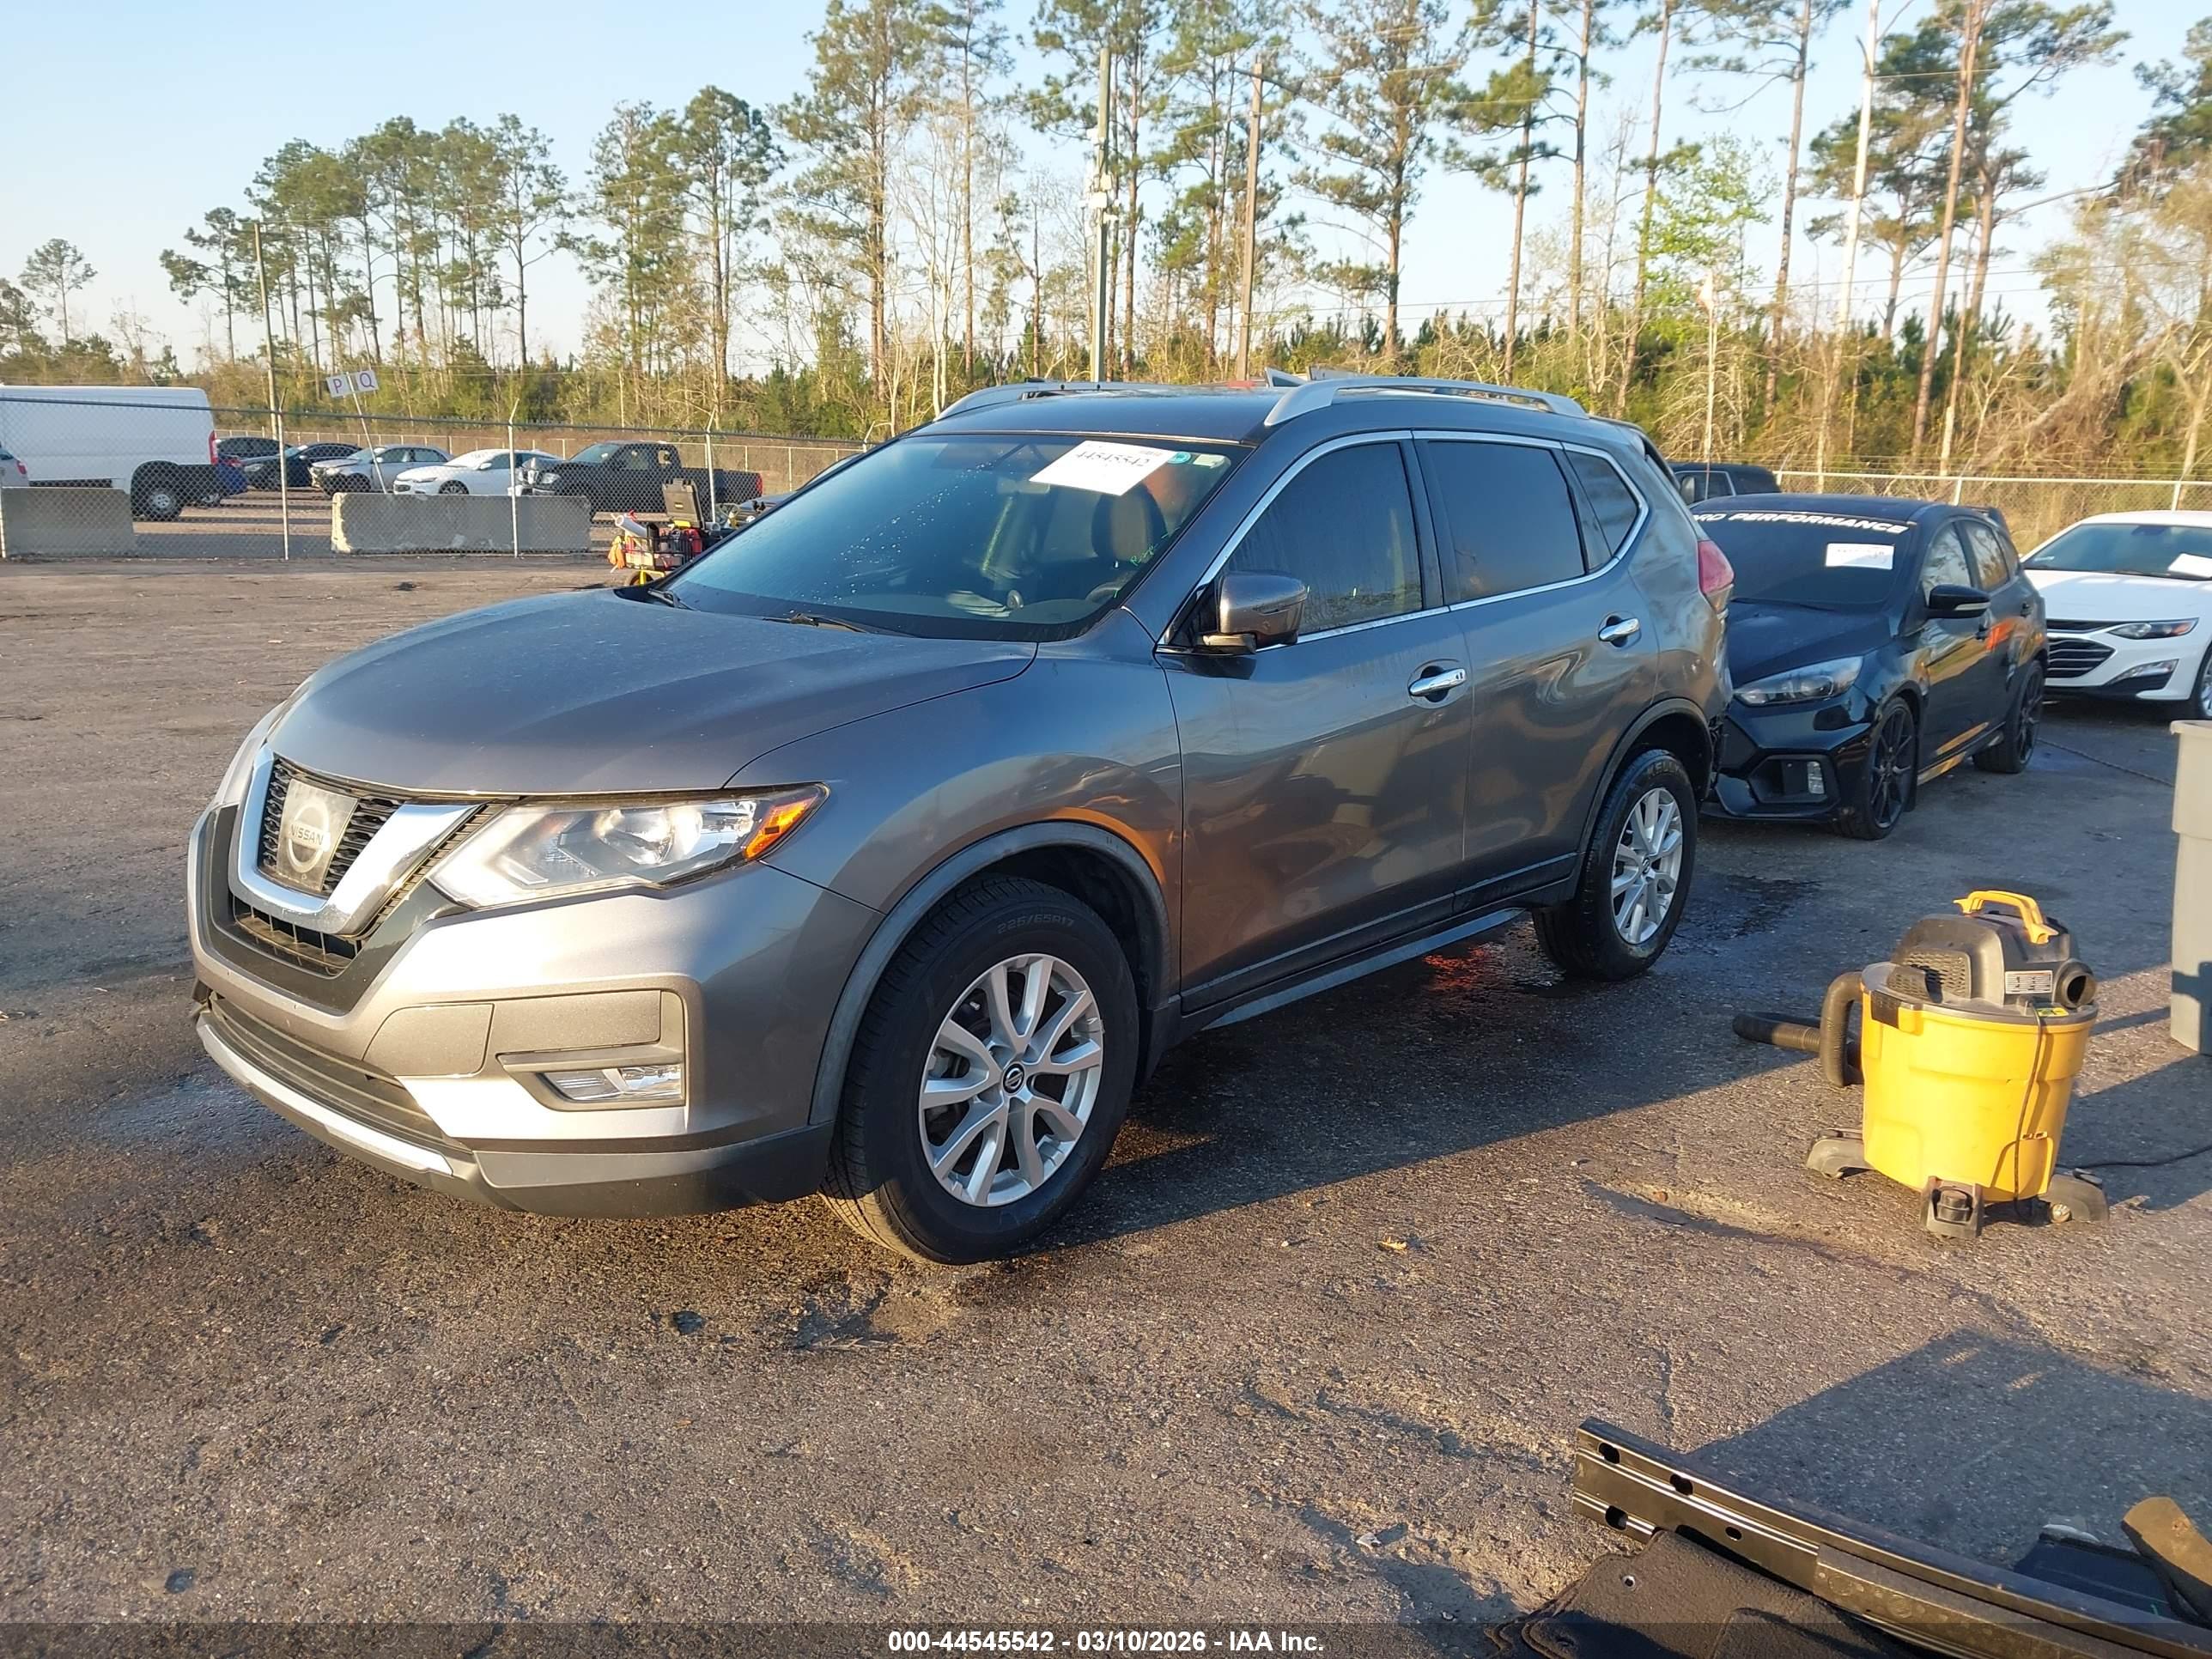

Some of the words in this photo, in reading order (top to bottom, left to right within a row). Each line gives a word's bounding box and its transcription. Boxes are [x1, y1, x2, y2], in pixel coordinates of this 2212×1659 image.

[333, 379, 342, 393] P
[360, 373, 375, 388] Q
[1729, 513, 1909, 534] PERFORMANCE
[289, 823, 324, 846] NISSAN
